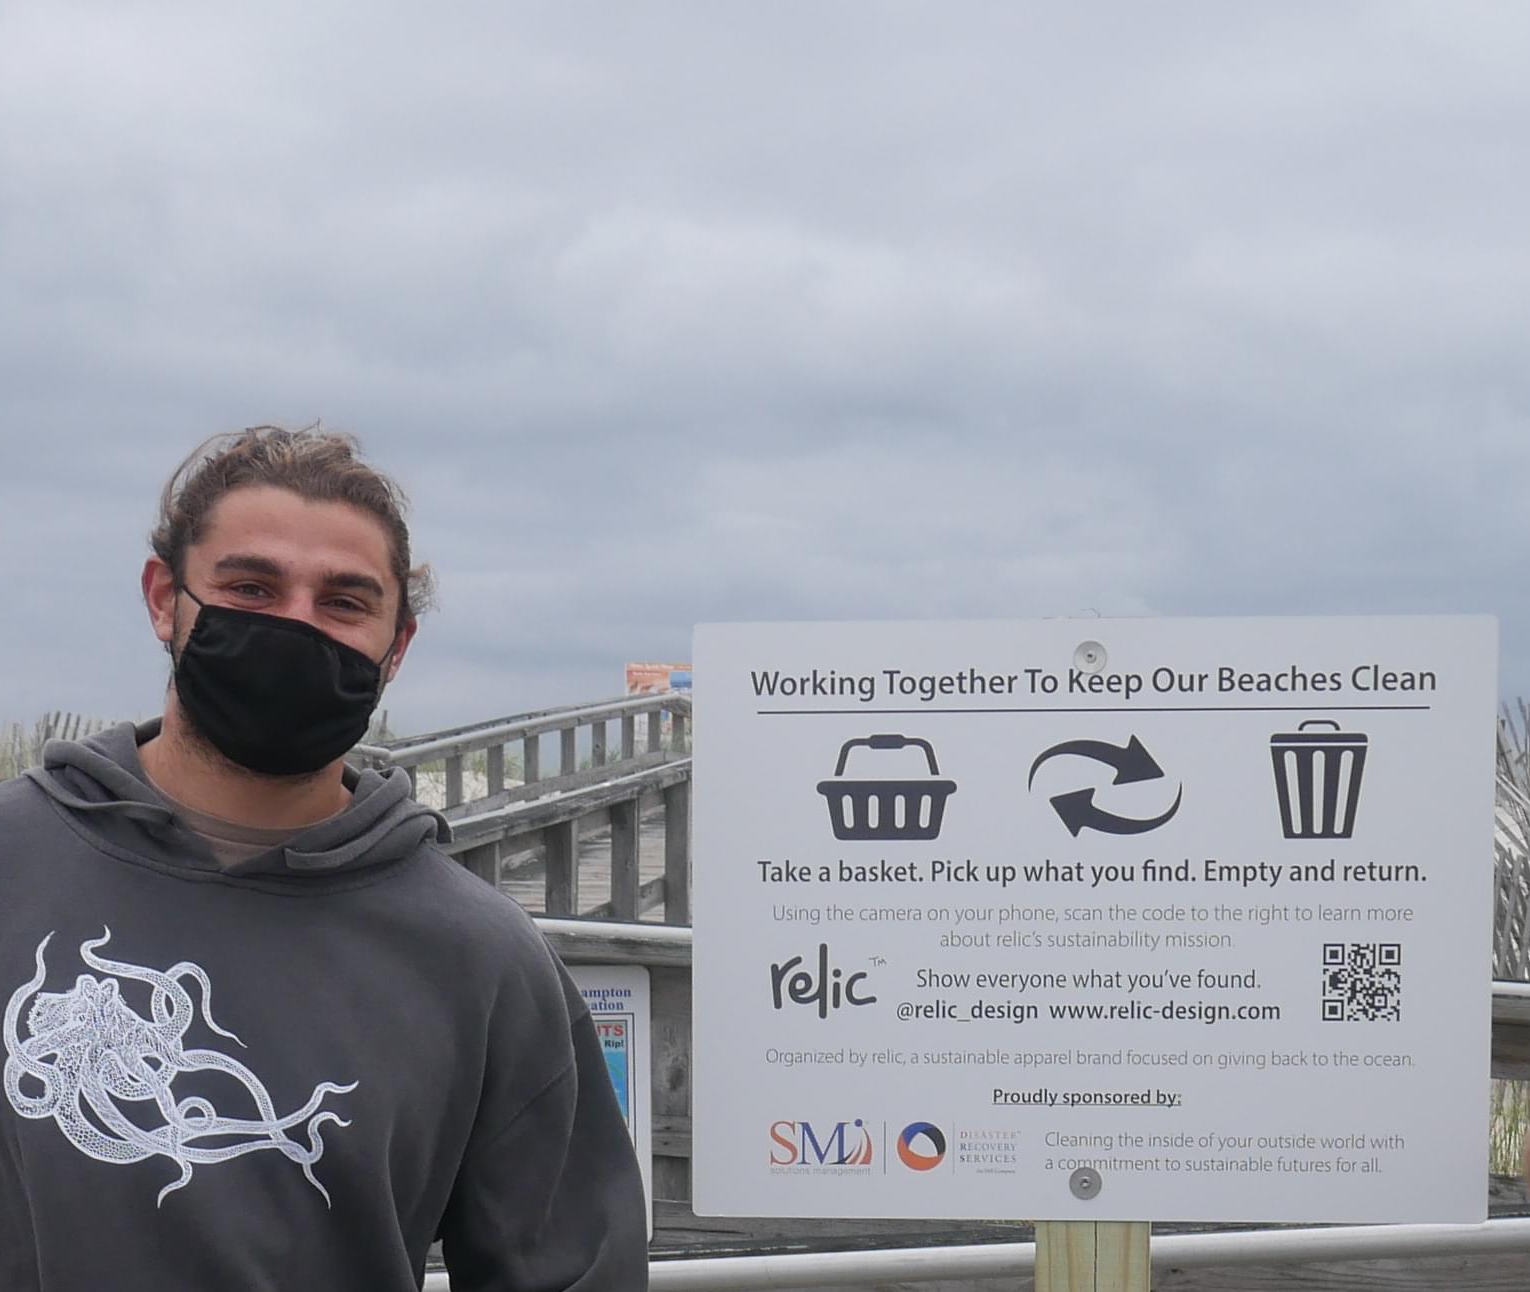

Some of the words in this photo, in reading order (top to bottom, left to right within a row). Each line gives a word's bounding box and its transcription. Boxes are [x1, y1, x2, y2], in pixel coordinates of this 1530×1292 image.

[751, 671, 875, 702] Working
[883, 669, 1018, 701] Together
[1024, 669, 1058, 694] To
[1068, 669, 1142, 699] Keep
[1152, 668, 1208, 693] Our
[1218, 665, 1342, 693] Beaches
[1352, 665, 1436, 691] Clean
[758, 861, 811, 882] Take
[819, 866, 831, 882] a
[839, 861, 923, 882] basket.
[932, 860, 978, 882] Pick
[987, 866, 1016, 887] up
[1024, 860, 1083, 882] what
[1092, 866, 1134, 887] you
[1142, 859, 1195, 881] find.
[1205, 860, 1282, 887] Empty
[1289, 860, 1334, 881] and
[1343, 862, 1427, 881] return.
[773, 905, 820, 924] Using
[827, 905, 853, 921] the
[860, 908, 921, 921] camera
[927, 908, 949, 921] on
[955, 908, 992, 925] your
[999, 905, 1059, 925] phone,
[1065, 907, 1102, 921] scan
[1109, 904, 1136, 921] the
[1142, 904, 1185, 921] code
[1191, 906, 1208, 921] to
[1215, 904, 1242, 921] the
[1249, 904, 1289, 925] right
[1295, 906, 1312, 921] to
[1319, 904, 1361, 921] learn
[1368, 908, 1413, 921] more
[940, 931, 990, 947] about
[1048, 932, 1160, 951] sustainability
[1165, 932, 1235, 947] mission.
[771, 943, 877, 1019] relic
[917, 969, 970, 988] Show
[976, 972, 1066, 992] everyone
[1073, 970, 1122, 989] what
[1197, 970, 1261, 989] found.
[897, 1001, 1038, 1024] @relic_design
[1049, 1001, 1280, 1024] www.relic-design.com
[766, 1049, 844, 1067] Organized
[849, 1049, 868, 1067] by
[873, 1049, 906, 1065] relic,
[911, 1053, 918, 1064] a
[923, 1049, 1009, 1065] sustainable
[1014, 1050, 1071, 1068] apparel
[1077, 1050, 1121, 1065] brand
[1127, 1050, 1187, 1065] focused
[1193, 1054, 1212, 1065] on
[1218, 1051, 1265, 1069] giving
[1272, 1051, 1307, 1066] back
[1313, 1053, 1328, 1066] to
[1334, 1051, 1359, 1066] the
[1364, 1055, 1415, 1067] ocean.
[993, 1089, 1057, 1107] Proudly
[1062, 1089, 1151, 1107] sponsored
[1156, 1090, 1181, 1107] by:
[960, 1143, 1016, 1151] RECOVERY
[1045, 1132, 1113, 1150] Cleaning
[1119, 1132, 1144, 1148] the
[1149, 1132, 1194, 1148] inside
[1199, 1132, 1216, 1148] of
[1218, 1136, 1252, 1151] your
[1258, 1134, 1316, 1149] outside
[1320, 1134, 1365, 1150] world
[1370, 1134, 1404, 1150] with
[959, 1155, 1017, 1163] SERVICES
